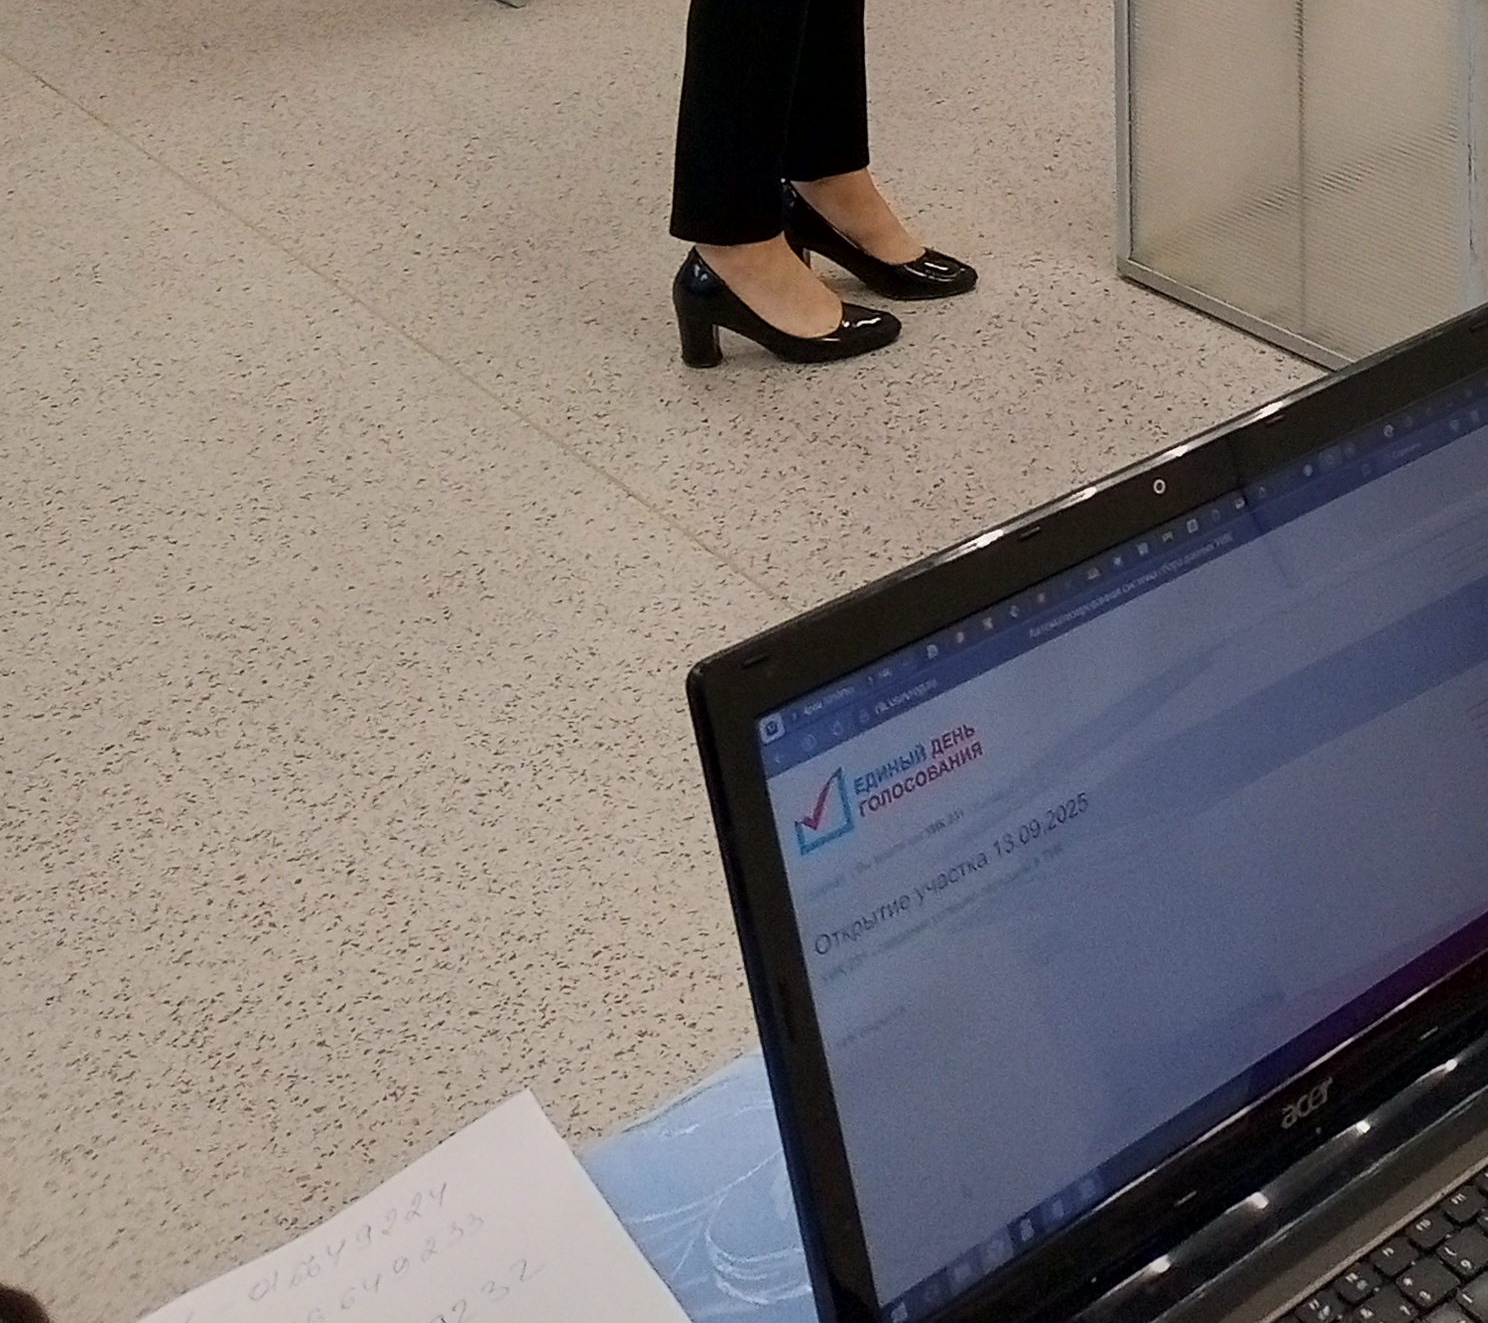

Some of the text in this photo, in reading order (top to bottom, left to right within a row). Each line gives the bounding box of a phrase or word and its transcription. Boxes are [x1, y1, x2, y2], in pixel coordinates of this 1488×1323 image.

[854, 724, 976, 795] ЕДИНЫЙ ДЕНЬ
[858, 742, 984, 818] ГОЛОСОВАНИЯ
[814, 893, 911, 956] Открытие
[914, 851, 989, 902] участка
[1280, 1076, 1333, 1130] acer
